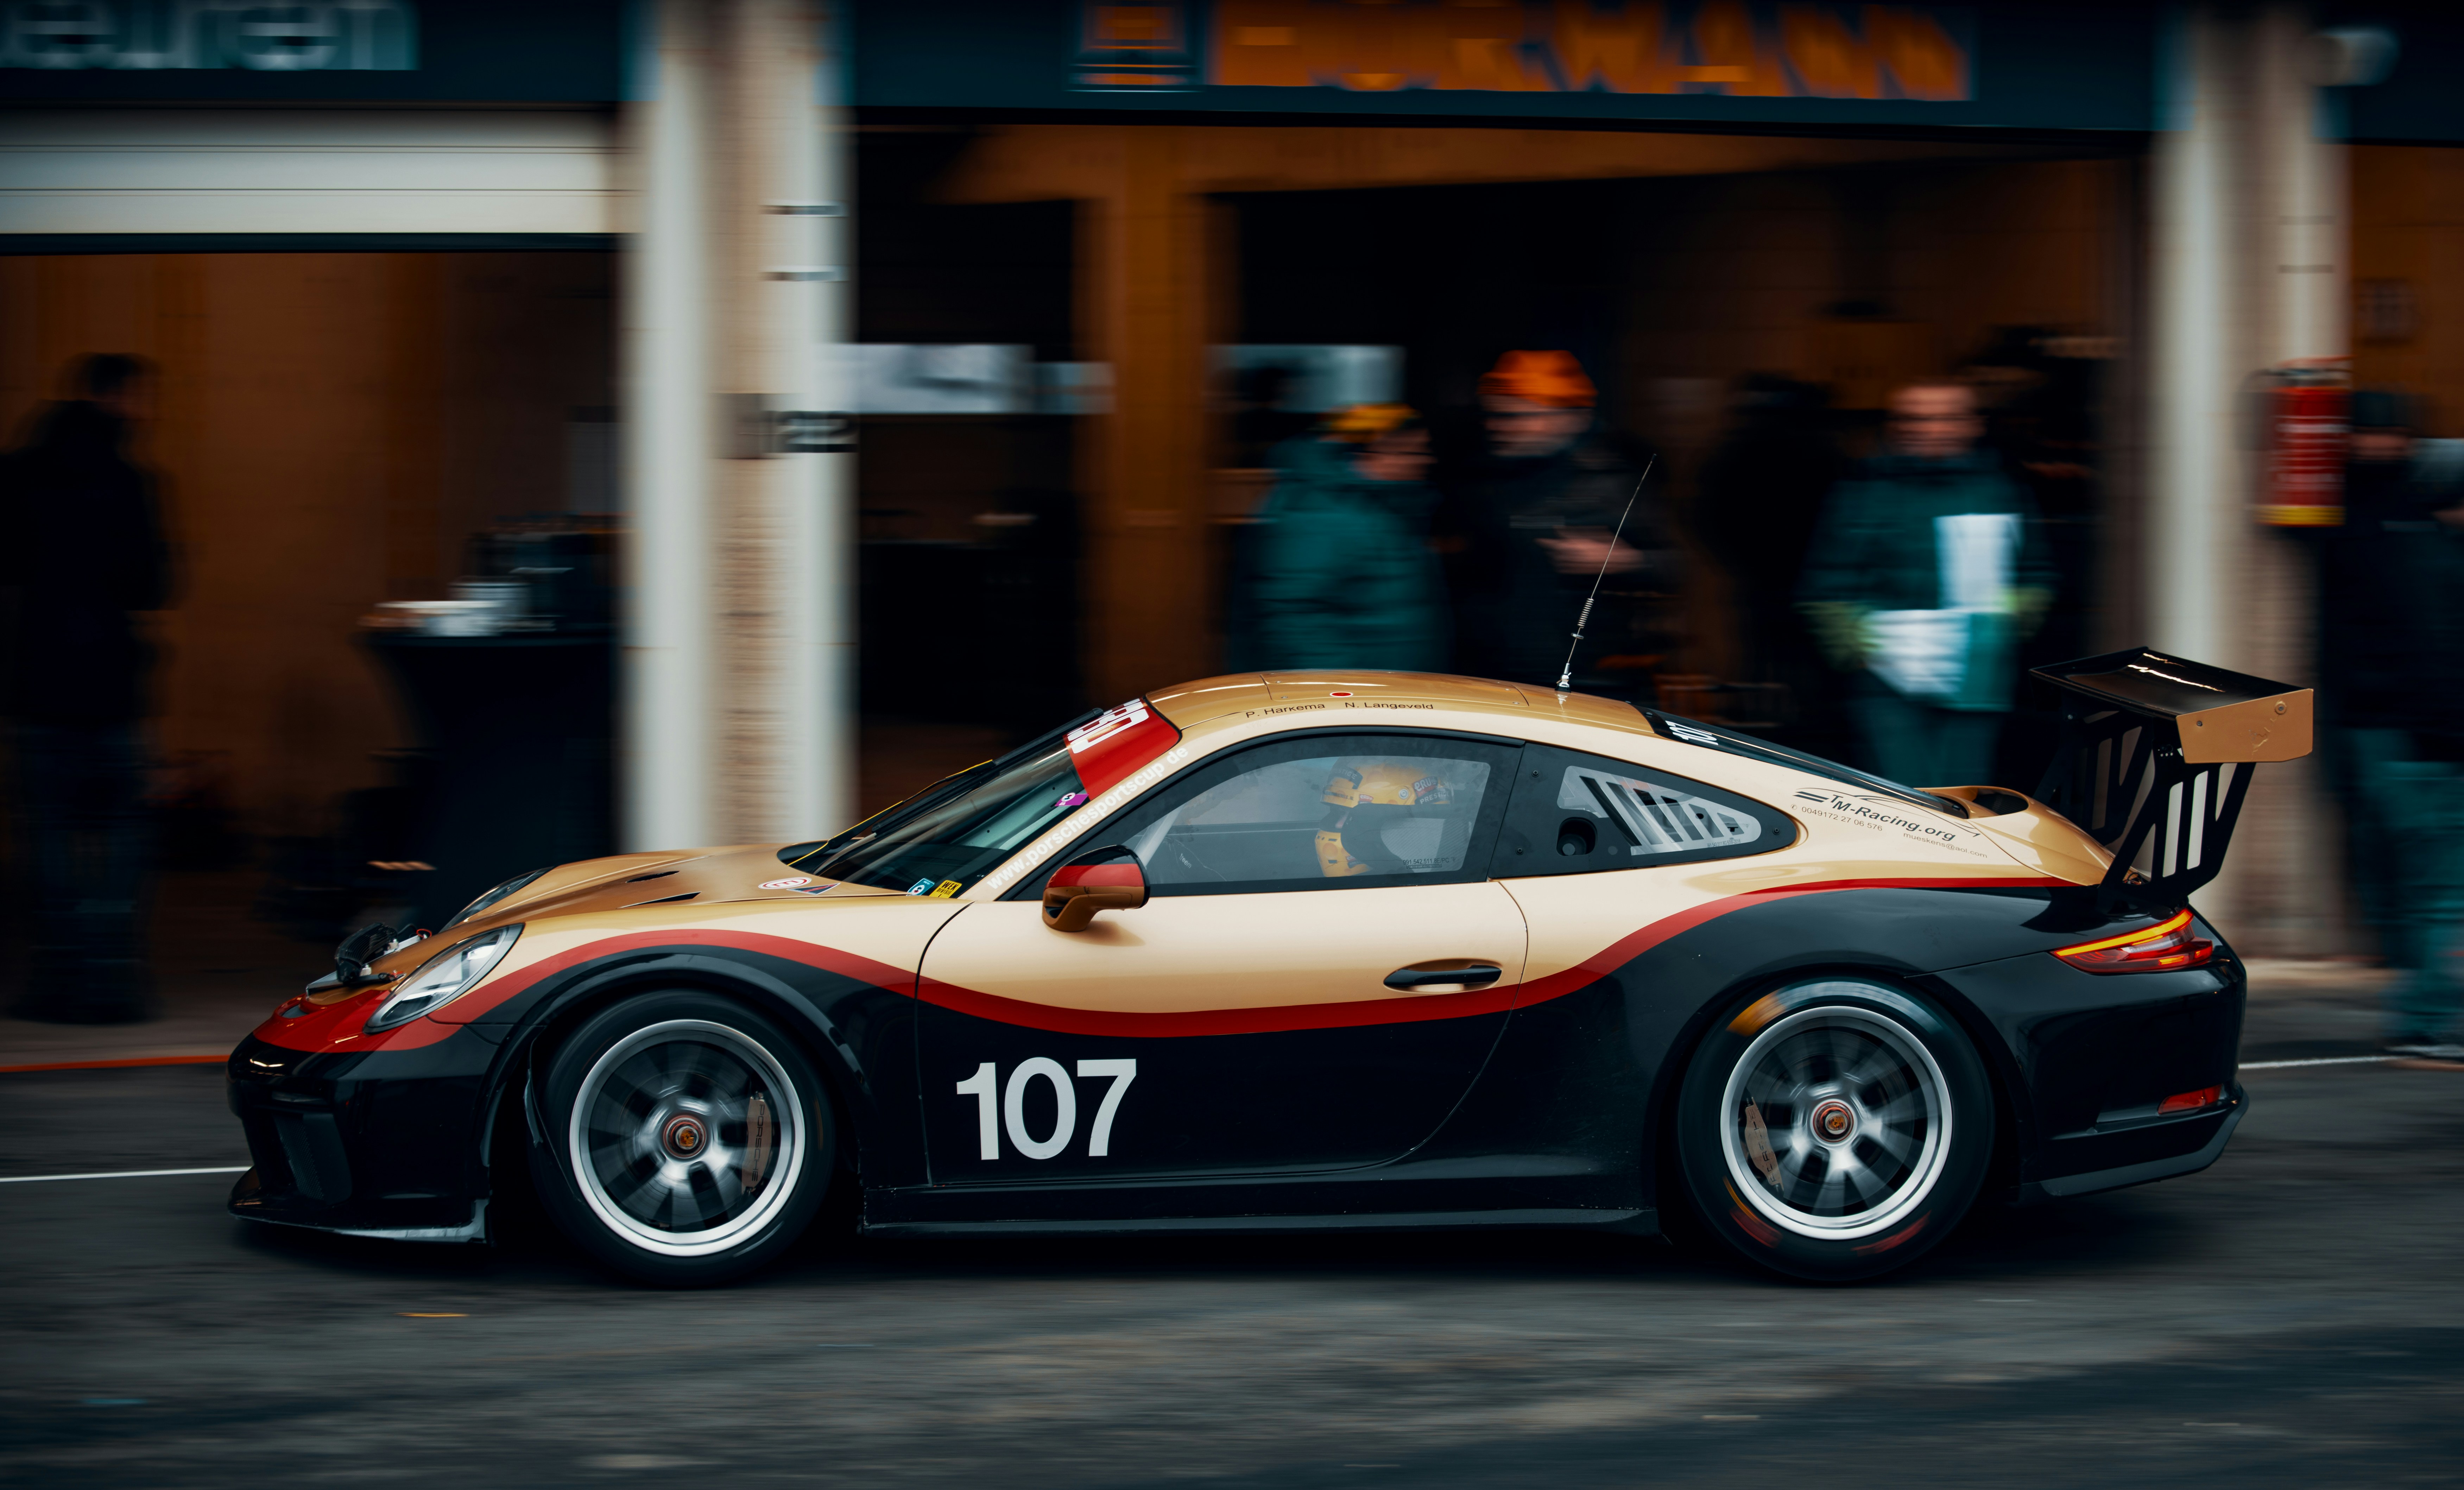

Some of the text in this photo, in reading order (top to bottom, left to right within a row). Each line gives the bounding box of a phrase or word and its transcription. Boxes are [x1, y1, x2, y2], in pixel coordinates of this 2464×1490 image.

[1265, 702, 1325, 715] Harkema
[1420, 791, 1450, 804] PRESTIGE
[1801, 806, 1838, 820] 0049172
[1867, 823, 1883, 831] 576
[1903, 833, 1988, 858] mueskens@aol.com
[956, 1057, 1137, 1160] 107
[752, 1104, 765, 1182] PORSCHE
